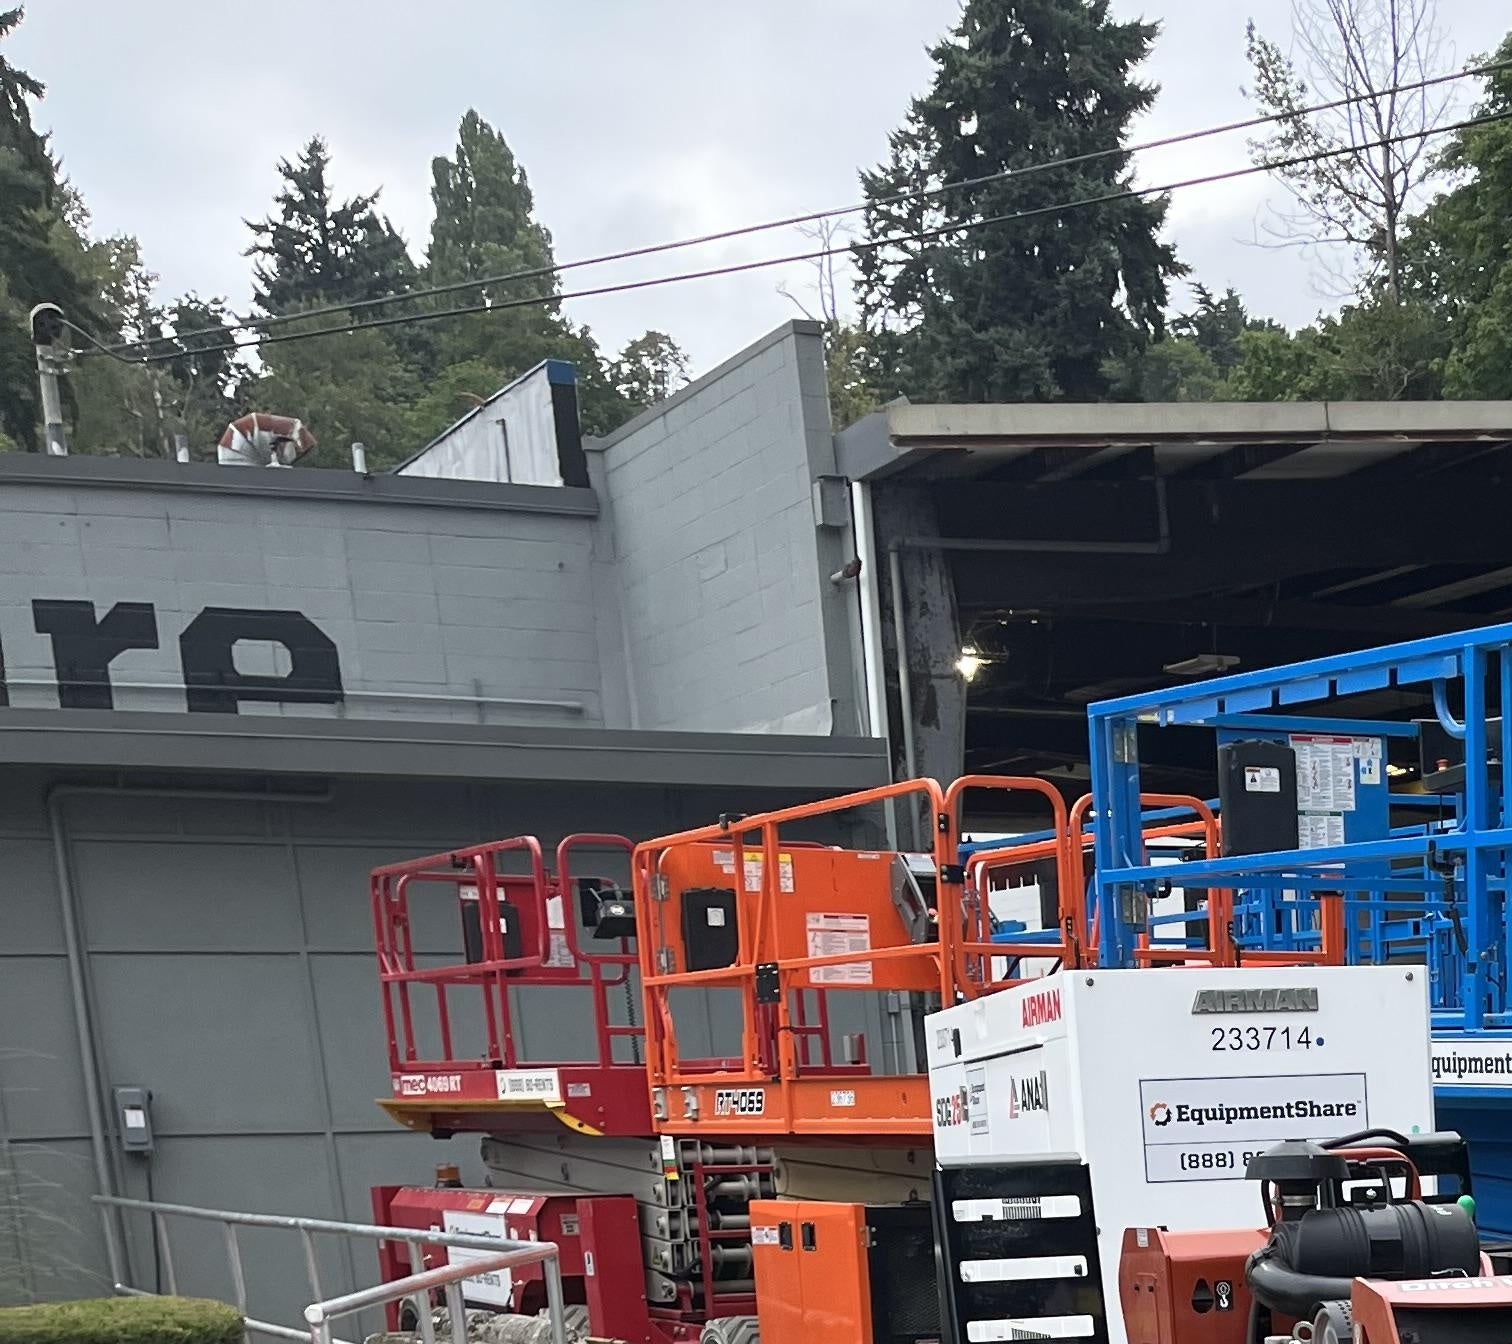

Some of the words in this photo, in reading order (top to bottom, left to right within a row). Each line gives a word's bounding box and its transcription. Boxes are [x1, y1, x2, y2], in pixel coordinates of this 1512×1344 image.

[0, 598, 344, 714] re
[1022, 988, 1062, 1029] AIRMAN
[1193, 988, 1317, 1013] AIRMAN
[1212, 1026, 1311, 1051] 233714
[716, 1090, 764, 1115] RT4069
[1176, 1100, 1357, 1125] EquipmentShare
[1181, 1151, 1234, 1170] (888)
[1401, 1278, 1493, 1291] Ditch
